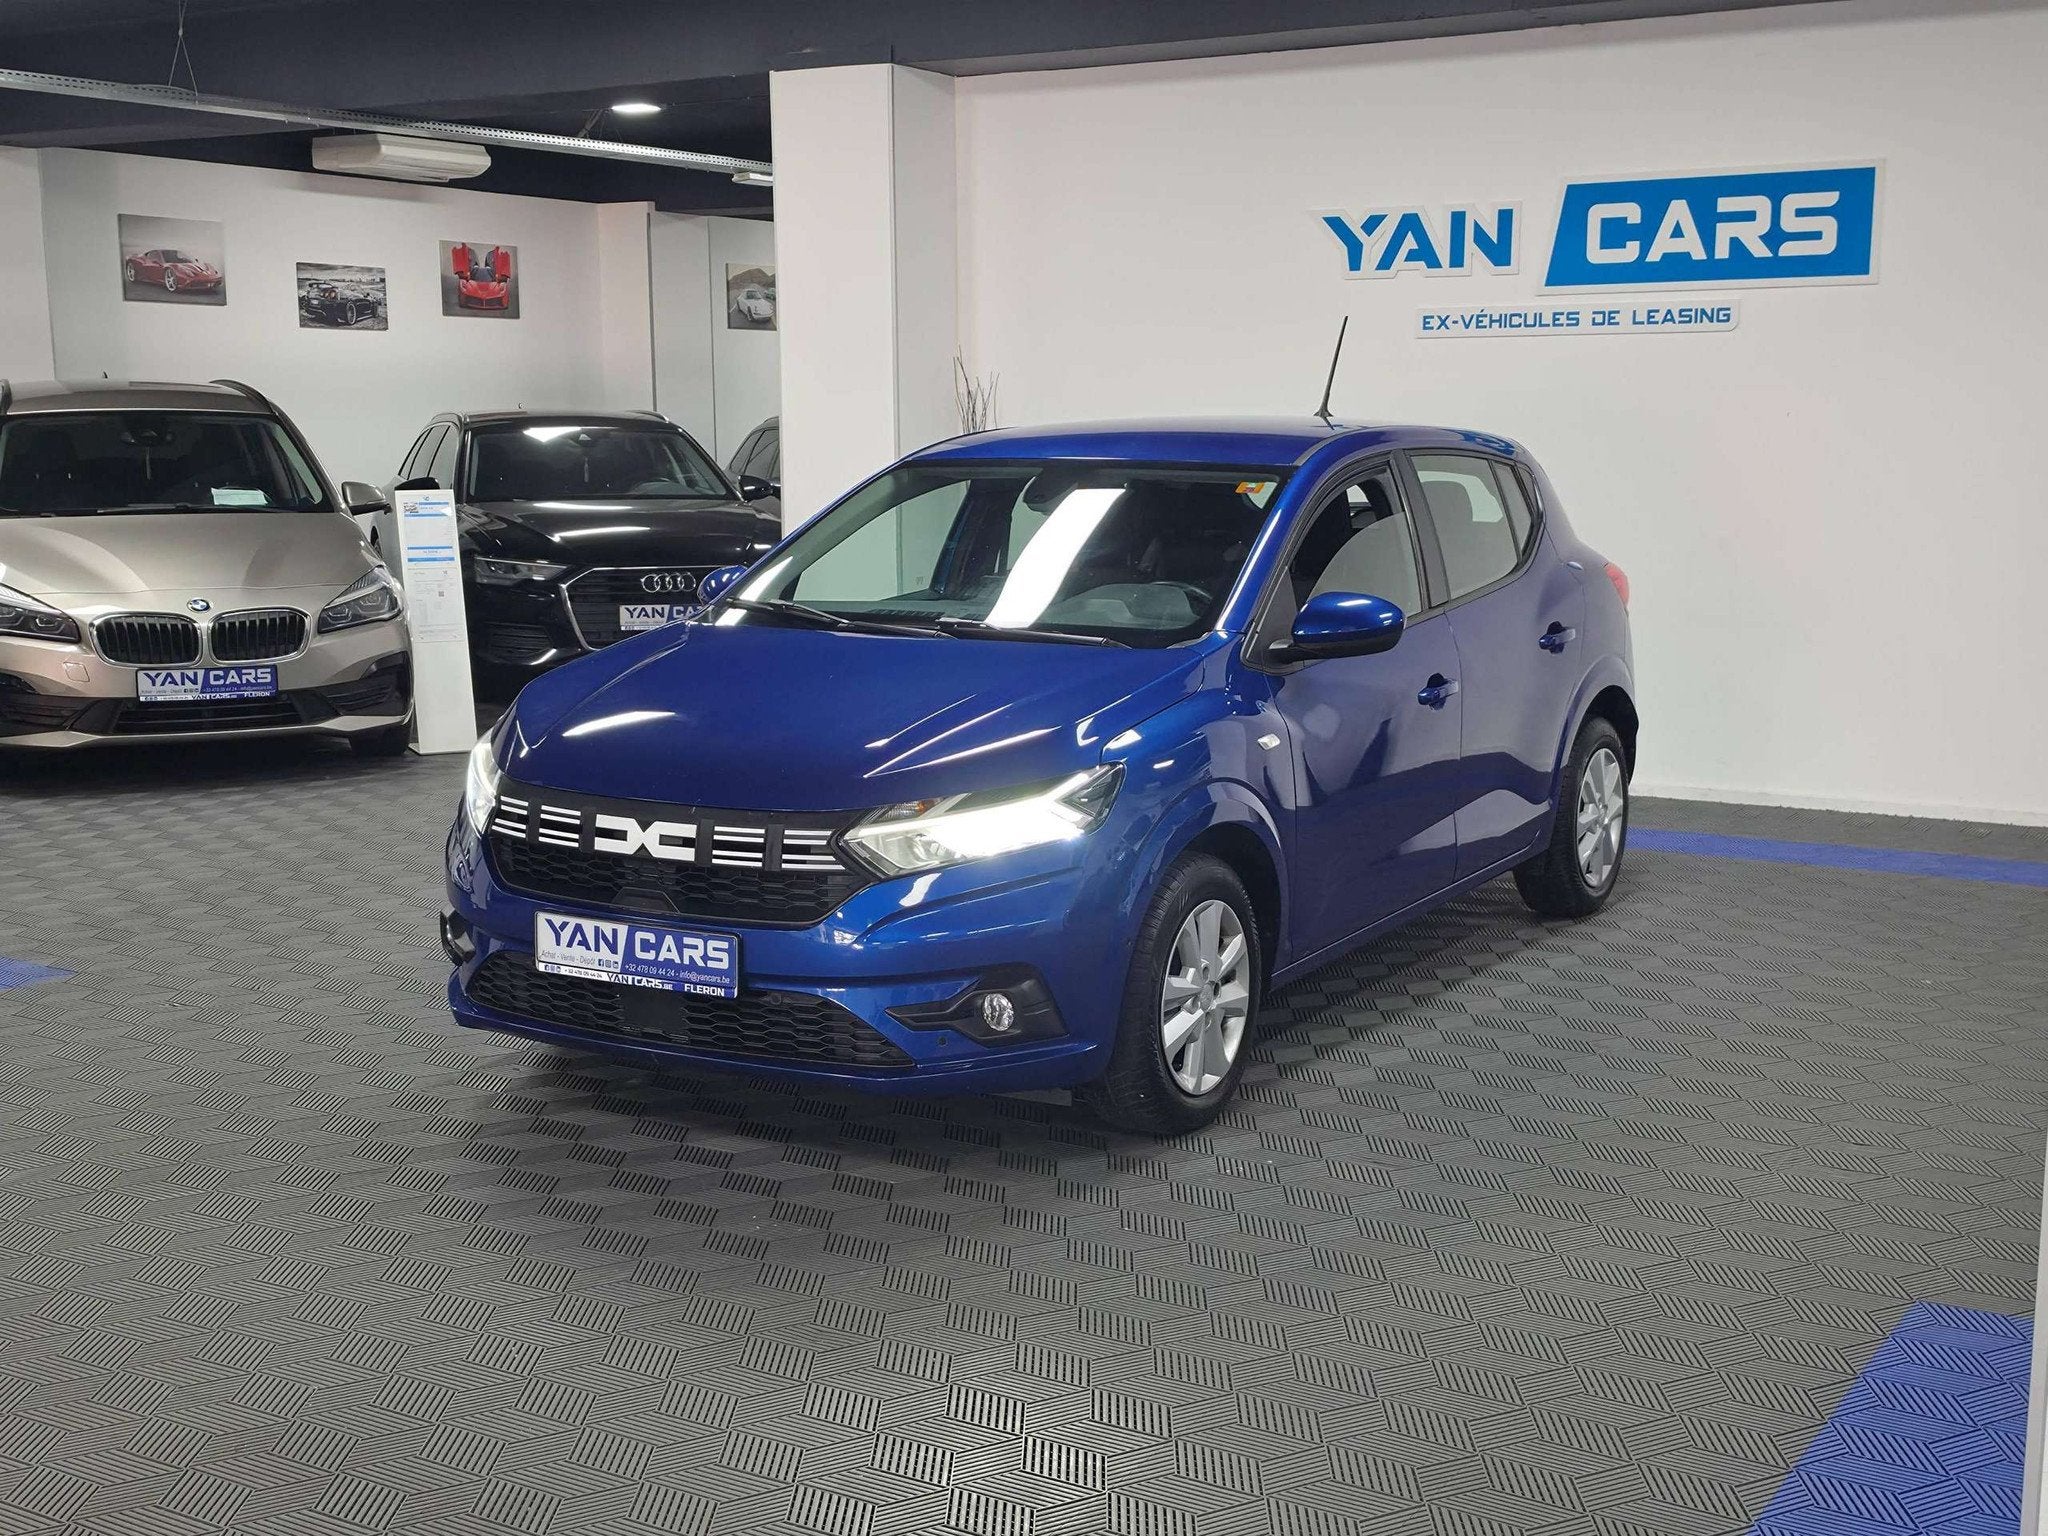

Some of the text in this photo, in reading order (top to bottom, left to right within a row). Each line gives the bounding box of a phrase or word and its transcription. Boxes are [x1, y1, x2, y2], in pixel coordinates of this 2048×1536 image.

[1322, 190, 1841, 272] YAN CARS
[1421, 306, 1731, 331] EX-VÉHICULES DE LEASING
[625, 606, 703, 619] YAN CA
[143, 668, 272, 687] YAN CARS
[545, 918, 730, 970] YAN CARS
[607, 972, 630, 985] YAN
[684, 984, 725, 997] FLERON
[679, 969, 731, 984] info@yancars.be
